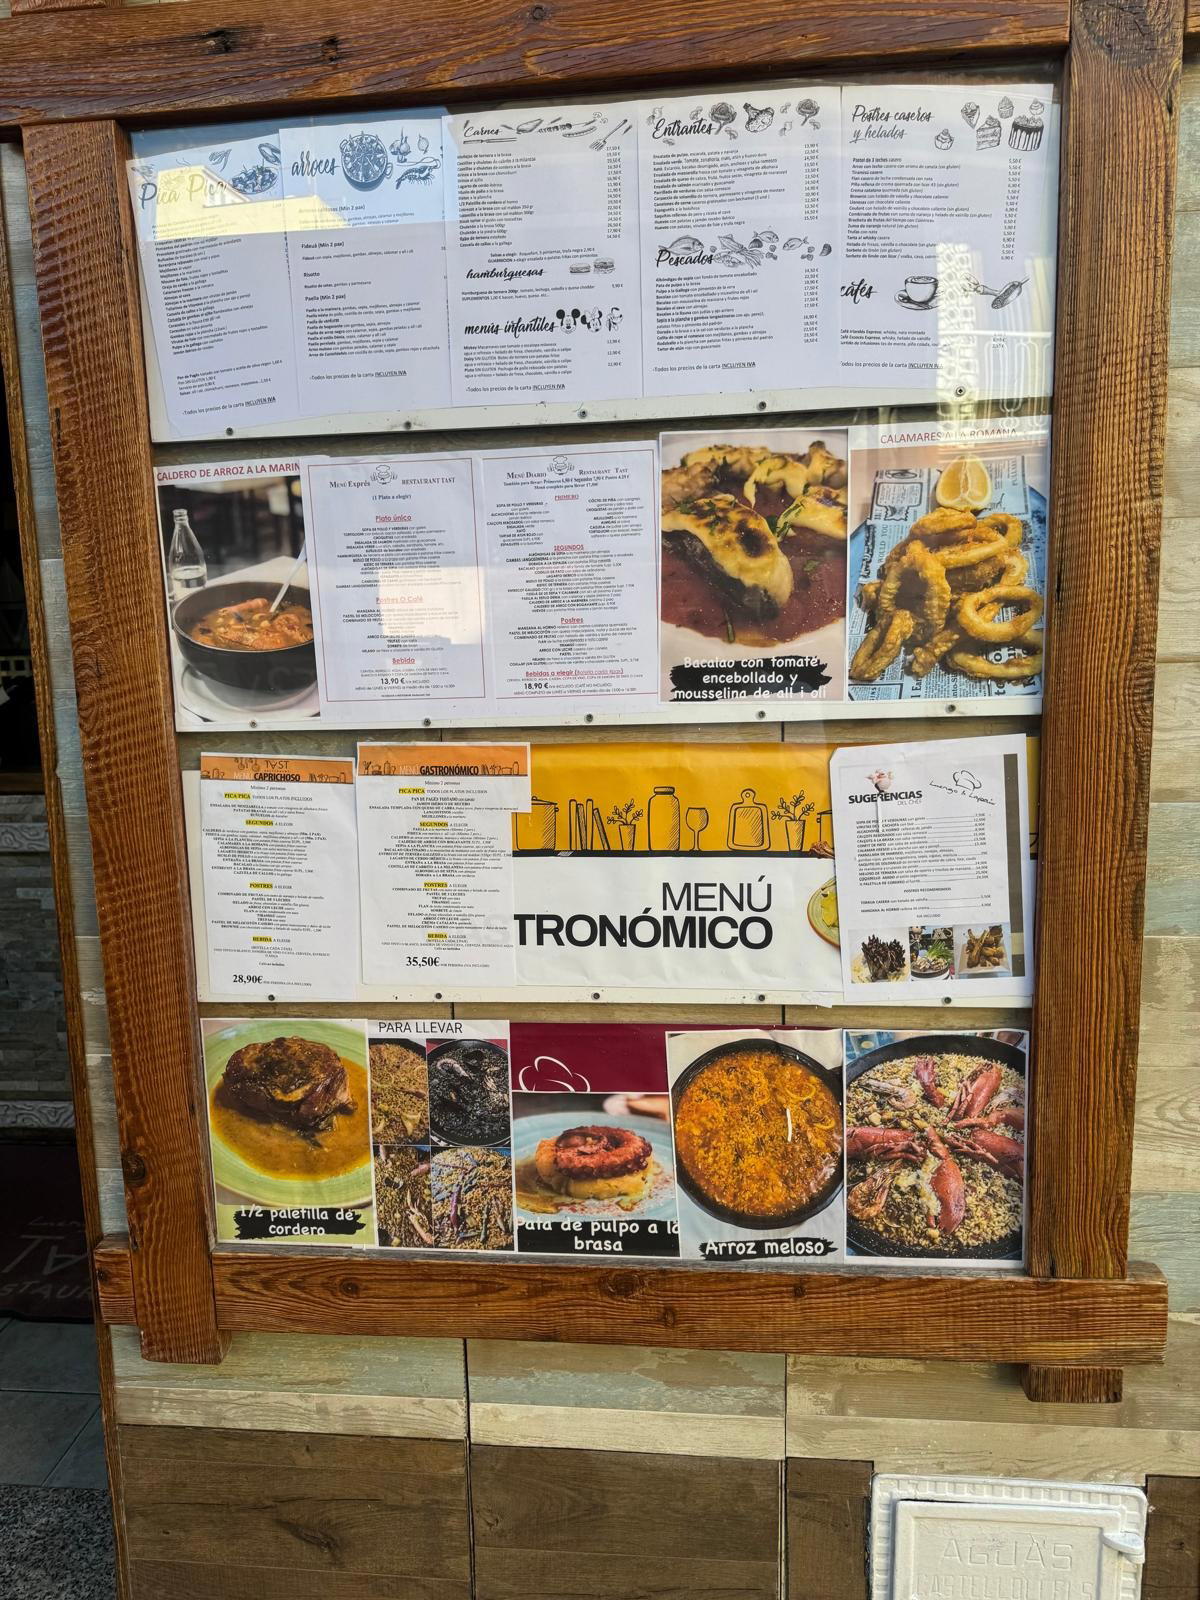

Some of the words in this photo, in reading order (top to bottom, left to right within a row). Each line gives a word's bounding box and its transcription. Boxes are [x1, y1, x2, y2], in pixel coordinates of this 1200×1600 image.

[852, 104, 890, 123] Postres
[894, 107, 935, 122] caseros
[463, 126, 502, 138] Carnes
[652, 118, 717, 139] Entrantes
[849, 127, 862, 144] y
[864, 125, 908, 140] helados
[291, 150, 341, 177] arroces
[655, 248, 715, 268] Pescados
[465, 268, 548, 281] hamburguesas
[464, 323, 502, 335] menús
[504, 316, 560, 338] infantiles
[677, 365, 695, 373] precios
[490, 384, 507, 392] precios
[532, 384, 556, 392] INCLUYEN
[880, 432, 943, 444] CALAMARES
[156, 469, 197, 482] CALDERO
[199, 469, 211, 477] DE
[213, 466, 244, 476] ARROZ
[246, 466, 254, 474] A
[255, 465, 267, 474] LA
[375, 515, 392, 523] Plato
[560, 617, 584, 625] Postres
[683, 656, 735, 669] Bacalao
[740, 658, 764, 668] con
[770, 656, 818, 668] tomate
[556, 669, 574, 677] elegir
[702, 672, 784, 684] encebollado
[789, 673, 798, 686] y
[673, 688, 748, 700] mousselina
[755, 687, 769, 699] de
[419, 763, 479, 776] GASTRONÓMICO
[253, 772, 301, 782] CAPRICHOSO
[848, 790, 923, 805] SUGERENCIAS
[661, 874, 773, 913] MENÚ
[513, 906, 774, 950] TRONÓMICO
[405, 956, 440, 967] 35,50€
[232, 974, 264, 985] 28,90€
[378, 1022, 413, 1033] PARA
[415, 1022, 464, 1034] LLEVAR
[239, 1205, 264, 1218] 1/2
[270, 1206, 329, 1221] paletilla
[335, 1207, 354, 1221] de
[268, 1221, 326, 1237] cordero
[516, 1217, 553, 1232] Pata
[560, 1216, 583, 1232] de
[590, 1219, 640, 1237] pulpo
[647, 1223, 659, 1235] a
[665, 1219, 680, 1235] la
[573, 1236, 623, 1252] brasa
[704, 1238, 757, 1256] Arroz
[763, 1237, 826, 1255] meloso
